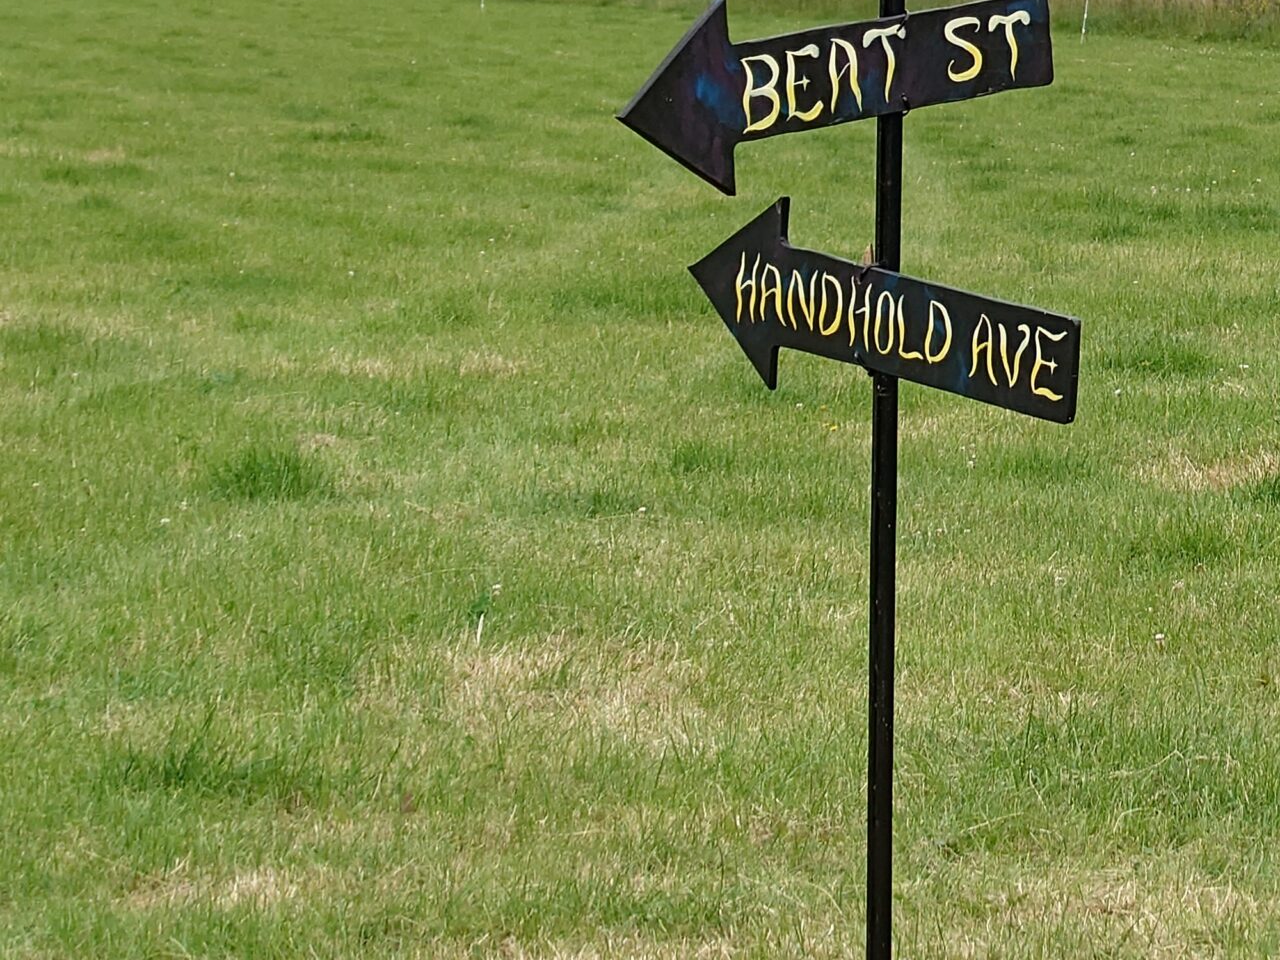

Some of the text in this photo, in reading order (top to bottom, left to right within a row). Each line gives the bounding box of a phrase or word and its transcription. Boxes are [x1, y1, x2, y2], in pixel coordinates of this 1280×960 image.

[740, 10, 1031, 135] BEAT ST
[735, 251, 1068, 402] HANDHOLD AVE
